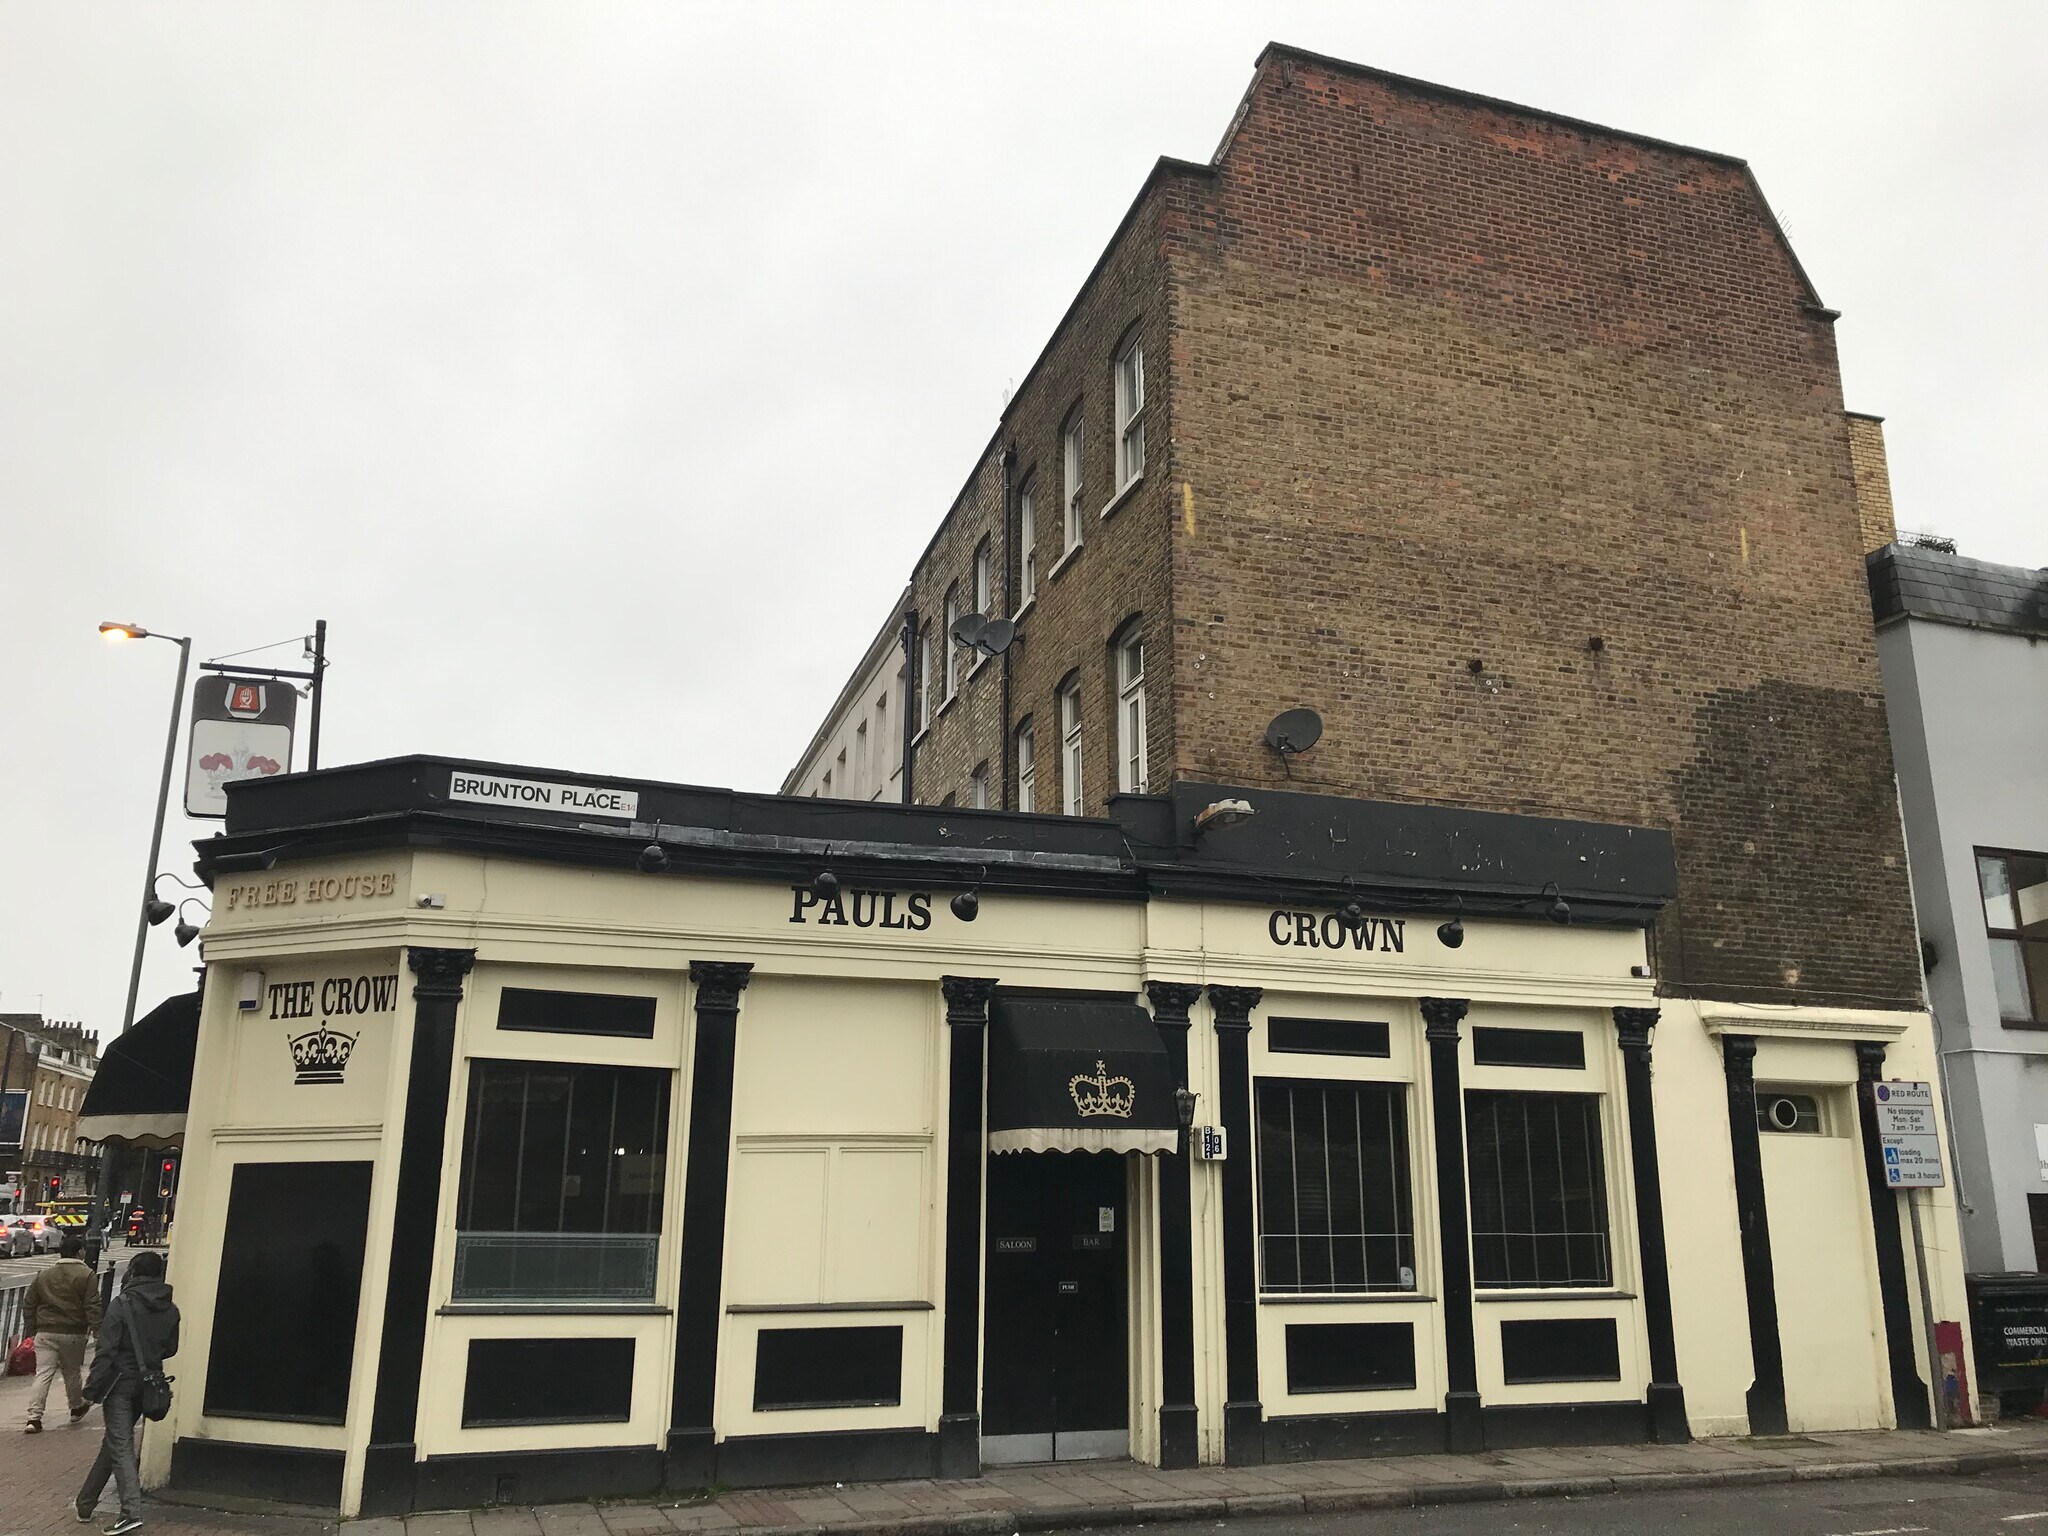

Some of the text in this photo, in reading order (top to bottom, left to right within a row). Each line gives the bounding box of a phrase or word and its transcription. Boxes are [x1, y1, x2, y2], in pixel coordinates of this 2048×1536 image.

[453, 778, 636, 812] BRUNTON PLACE E14
[227, 872, 396, 910] FREE HOUSE
[789, 885, 932, 931] PAULS
[1268, 910, 1406, 953] CROWN
[268, 981, 315, 1020] THE
[1898, 1108, 1924, 1116] stopping
[1000, 1240, 1032, 1249] SALOON
[1083, 1238, 1100, 1246] BAR
[2004, 1326, 2048, 1335] COMMERCIAL
[2006, 1336, 2047, 1346] WASTE ONLY
